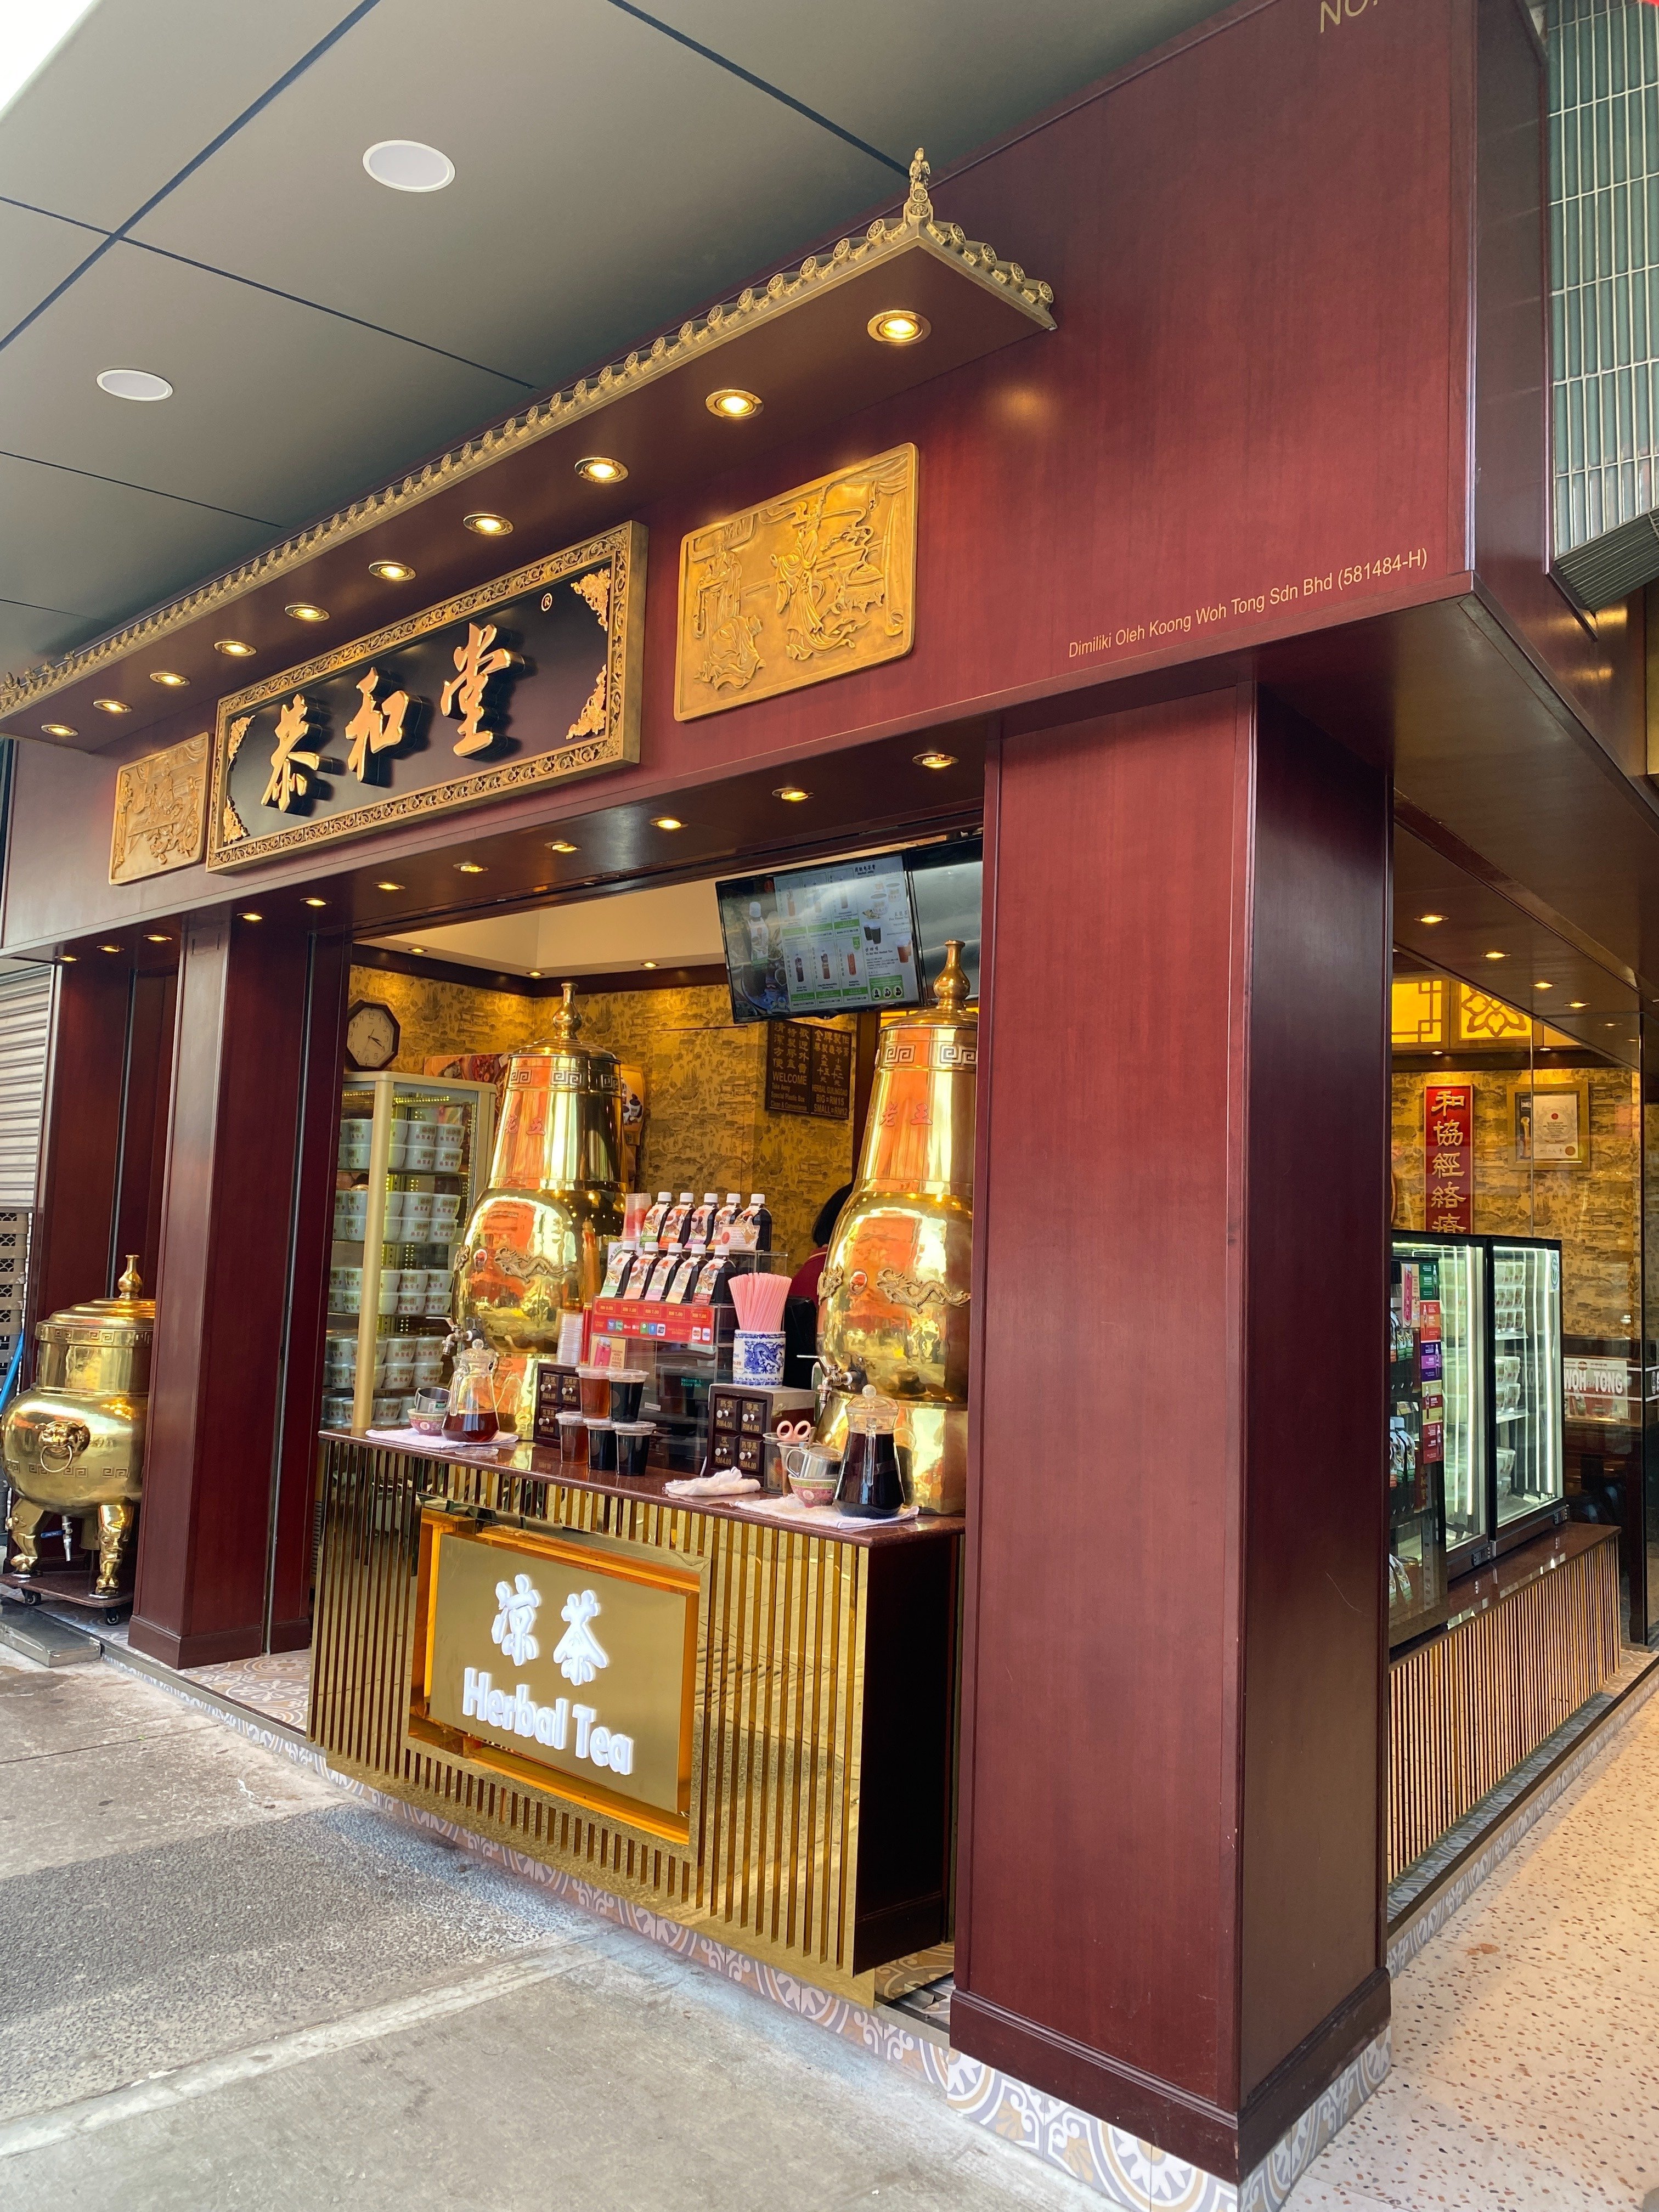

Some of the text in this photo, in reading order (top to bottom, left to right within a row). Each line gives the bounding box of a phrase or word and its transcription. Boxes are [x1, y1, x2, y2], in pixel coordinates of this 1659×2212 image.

[1069, 548, 1428, 658] Dimiliki Oleh Koong Woh Tong Sdn Bhd (581484-H)
[772, 1071, 808, 1085] WELCOME
[1593, 1370, 1623, 1394] TONG
[716, 1420, 732, 1428] RM4.00
[742, 1423, 759, 1432] RM4.00
[715, 1457, 732, 1465] RM4.00
[740, 1461, 757, 1469] RM4.00
[462, 1667, 634, 1775] Herbal Tea
